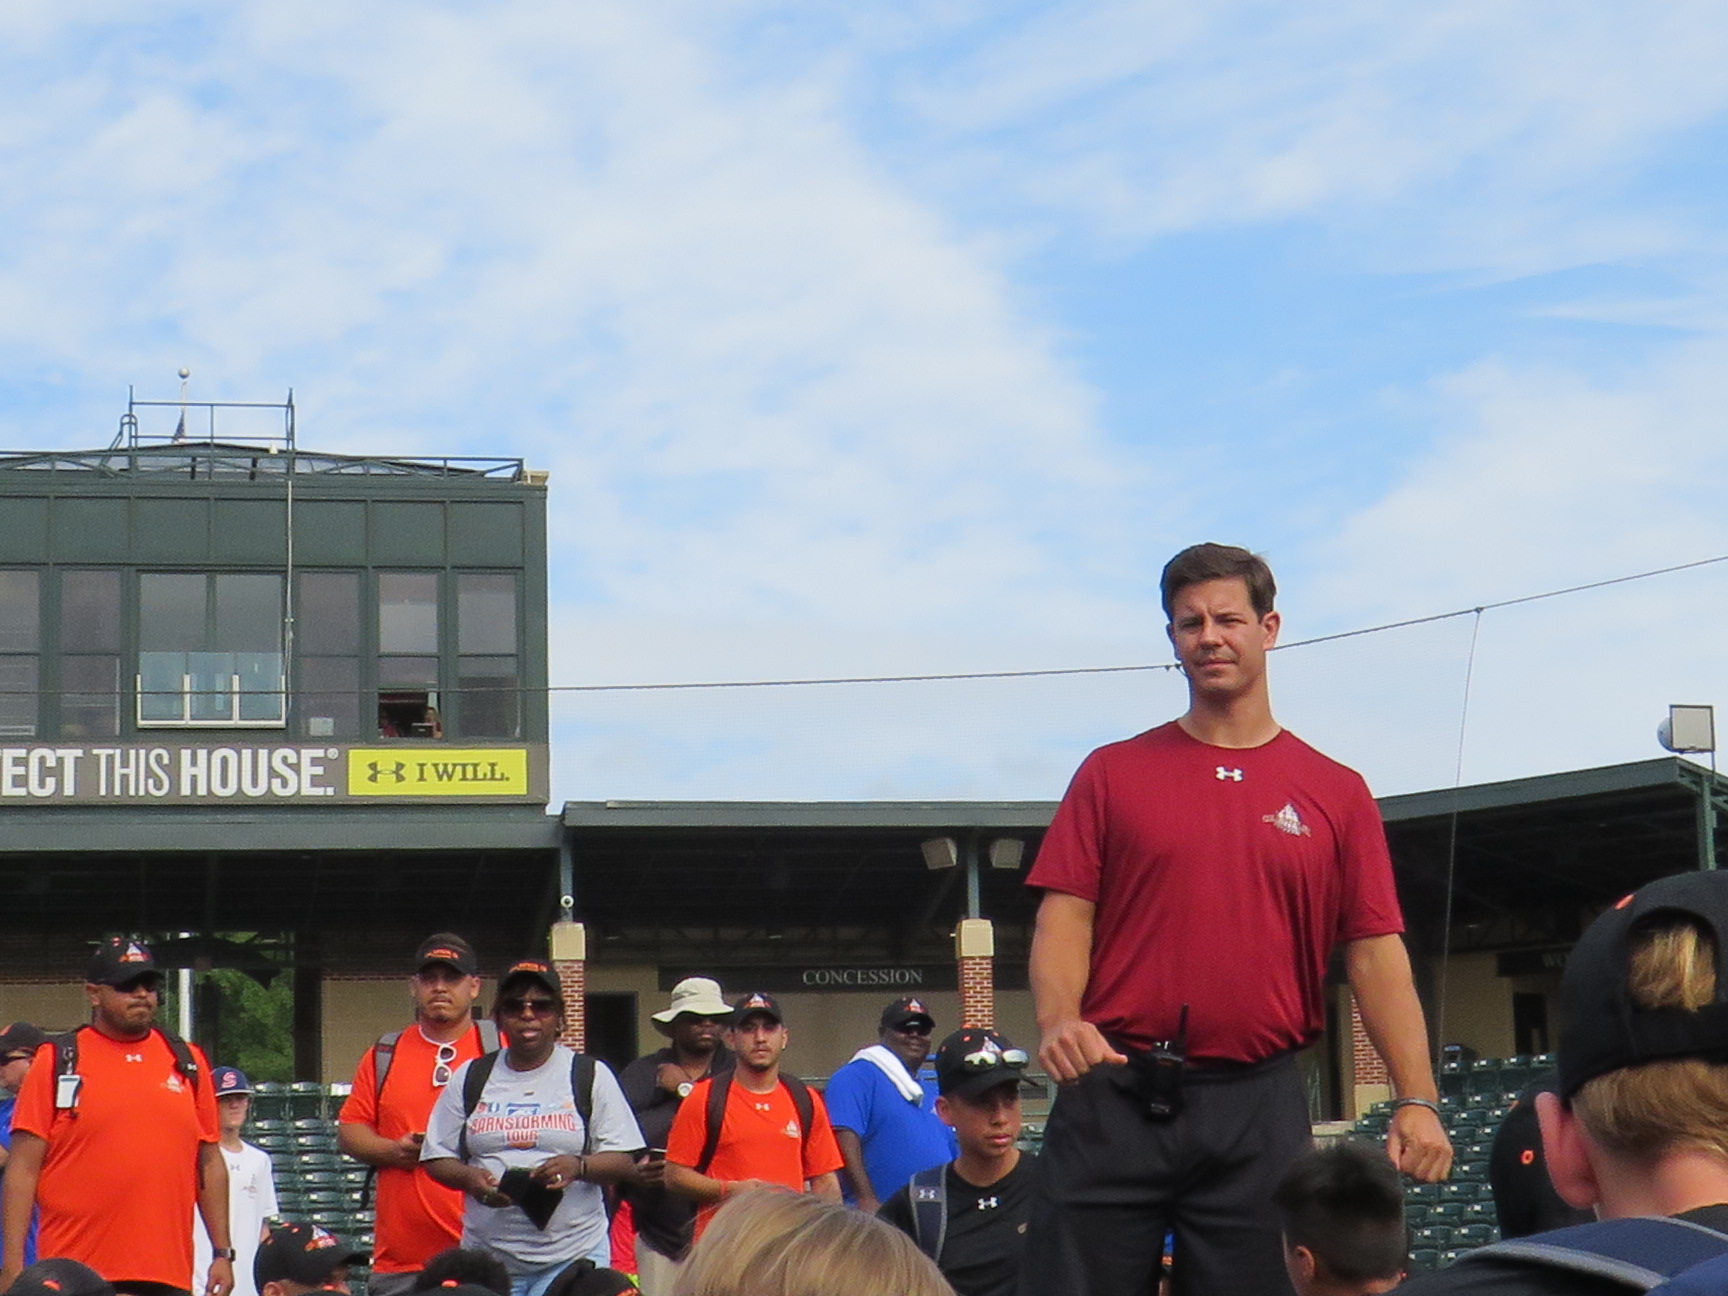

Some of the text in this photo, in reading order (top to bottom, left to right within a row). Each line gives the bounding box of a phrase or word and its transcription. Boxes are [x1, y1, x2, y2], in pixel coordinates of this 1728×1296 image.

[92, 748, 170, 797] THIS
[416, 762, 511, 782] I WILL.
[802, 968, 923, 985] CONCESSION
